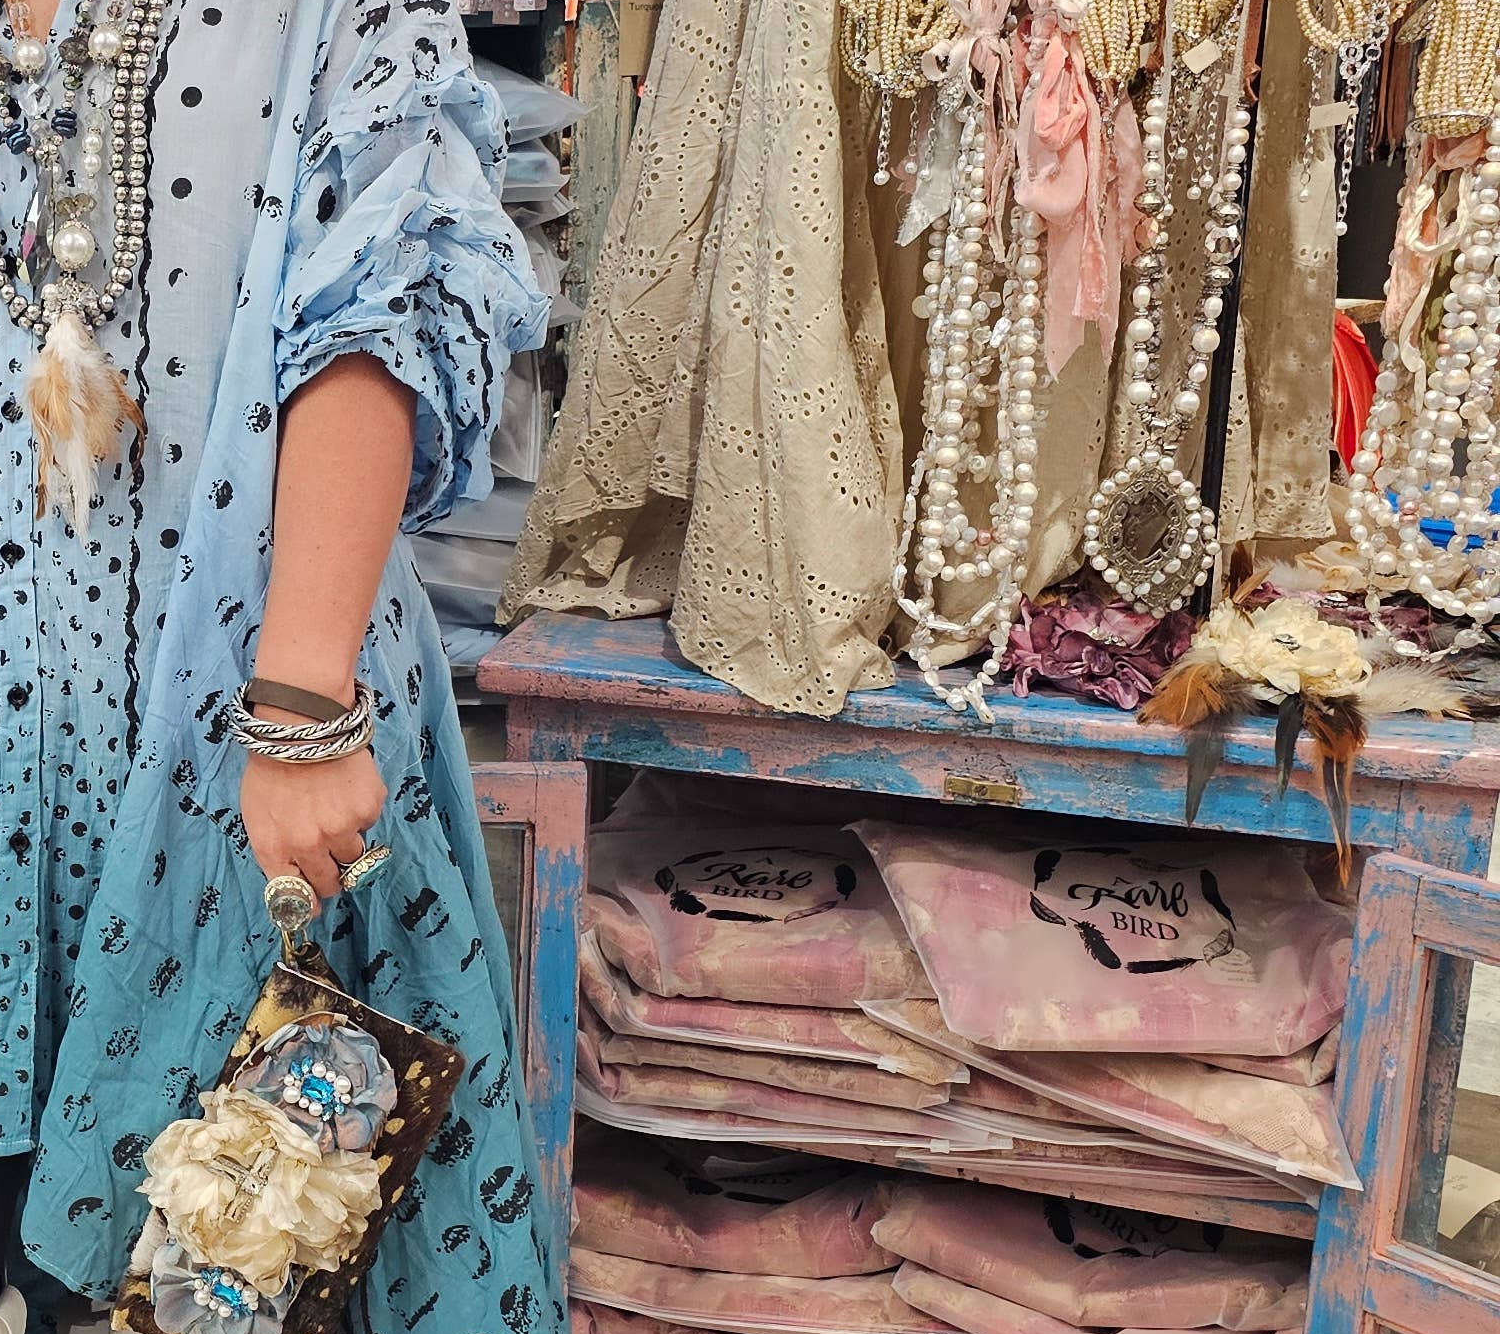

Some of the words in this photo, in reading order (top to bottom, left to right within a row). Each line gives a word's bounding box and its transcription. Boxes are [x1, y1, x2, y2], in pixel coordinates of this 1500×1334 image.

[696, 863, 813, 890] Rare
[711, 884, 785, 901] BIRD
[1067, 880, 1189, 918] Rare
[1110, 911, 1180, 941] BIRD
